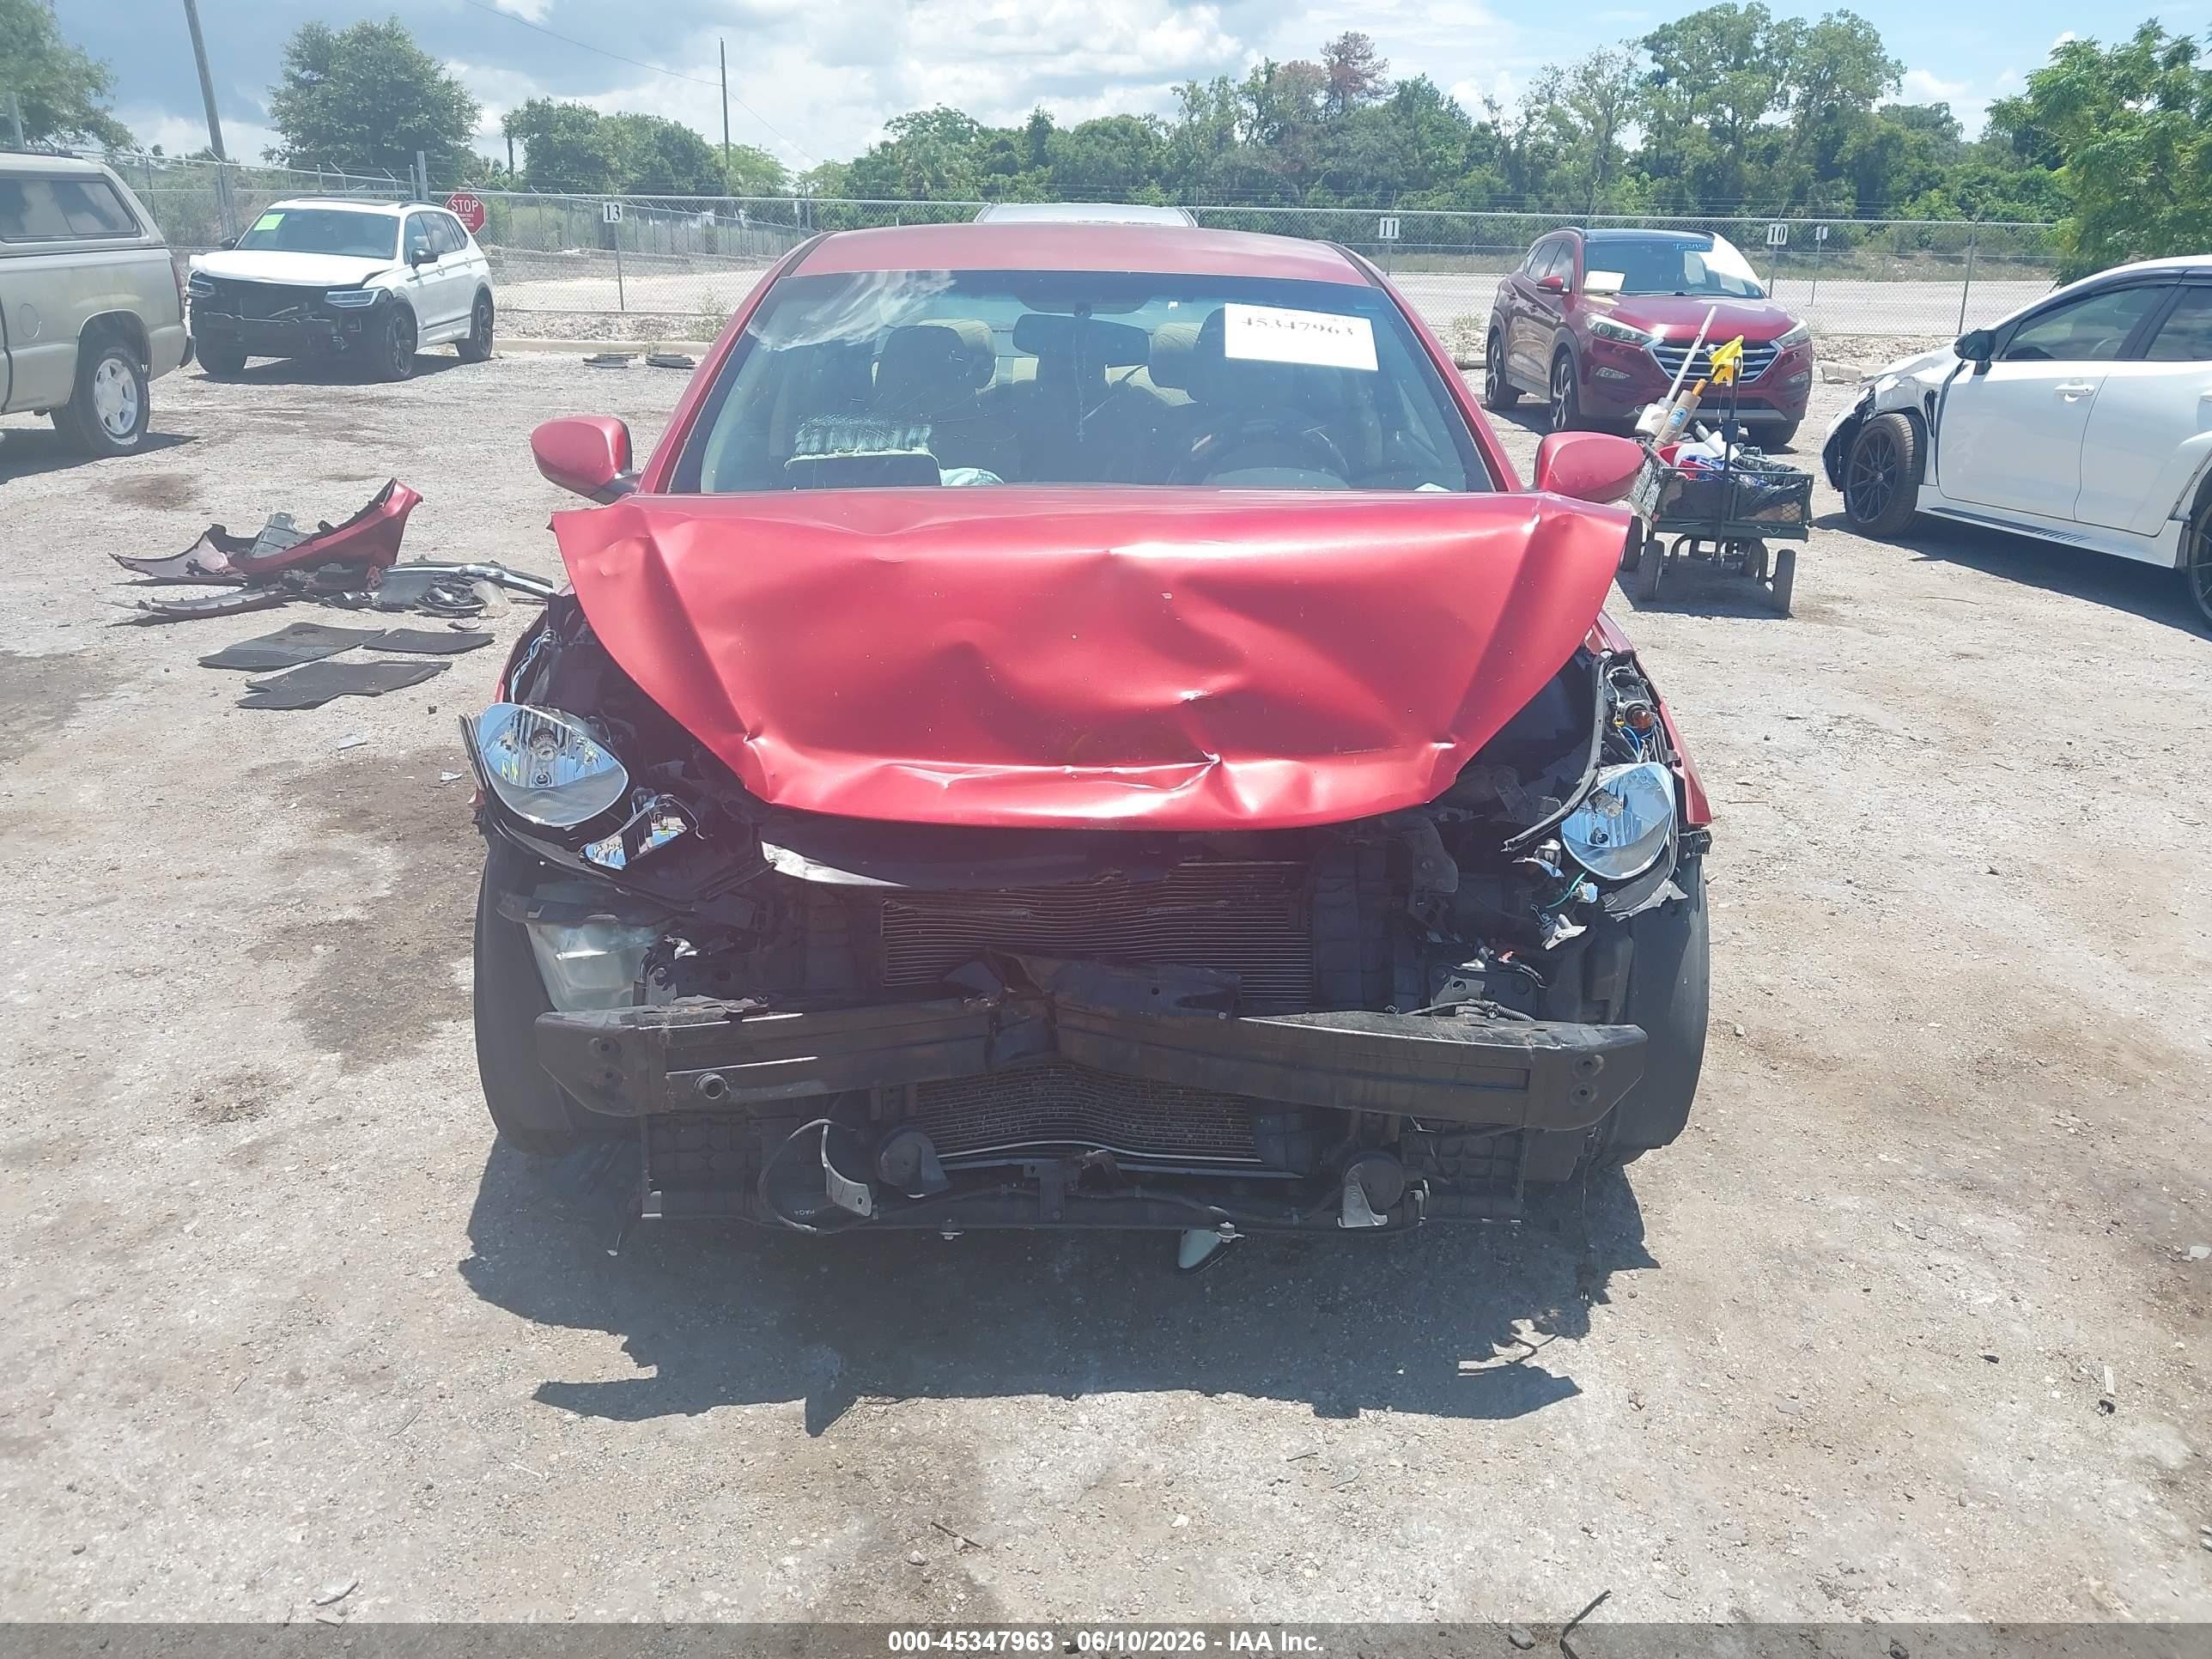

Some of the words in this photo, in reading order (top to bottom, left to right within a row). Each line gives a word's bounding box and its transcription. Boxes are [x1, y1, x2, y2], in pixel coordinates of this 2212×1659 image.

[451, 199, 478, 212] STOP
[605, 204, 620, 221] 13
[1382, 219, 1396, 236] 11
[1771, 226, 1786, 243] 10
